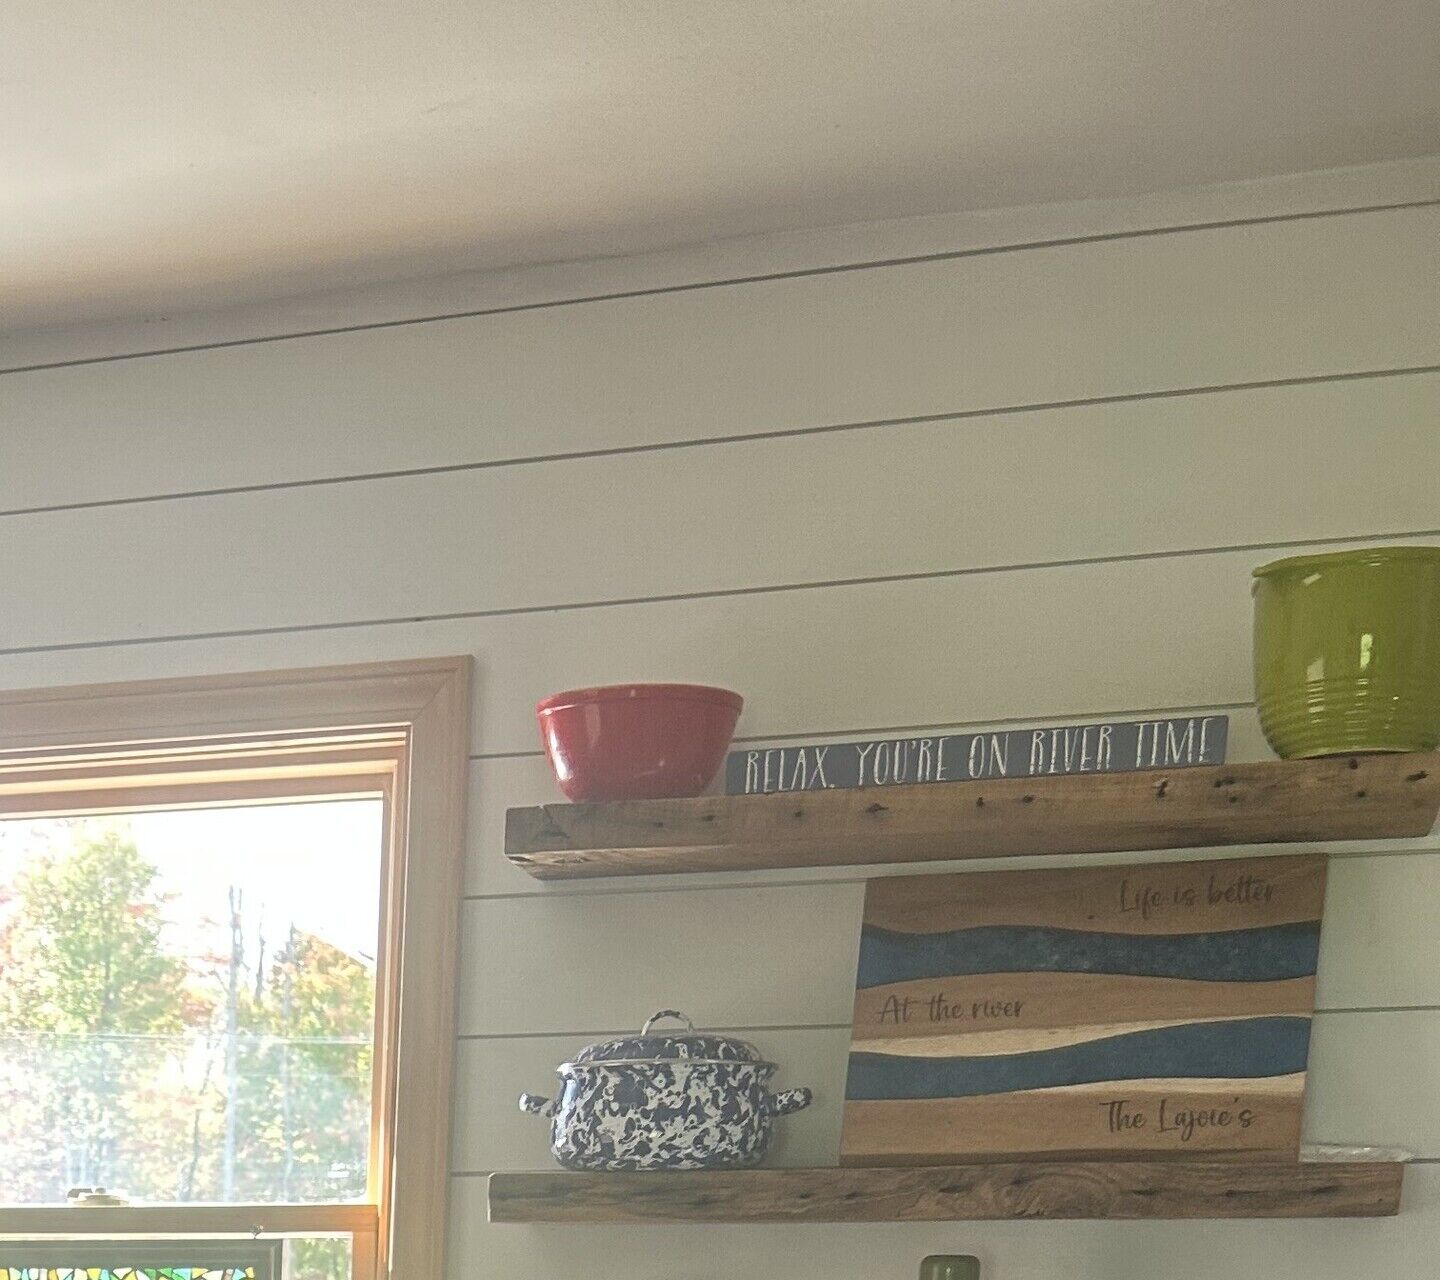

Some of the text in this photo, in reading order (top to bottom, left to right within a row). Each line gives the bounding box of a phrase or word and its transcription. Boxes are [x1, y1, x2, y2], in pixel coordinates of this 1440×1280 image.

[856, 737, 951, 787] YOU'RE
[969, 732, 1009, 778] ON
[1029, 725, 1113, 775] RIVER
[1134, 716, 1215, 768] TIME
[1120, 875, 1274, 920] Life is better
[876, 992, 1024, 1024] At the river
[1098, 1096, 1257, 1142] The Lajoie's
